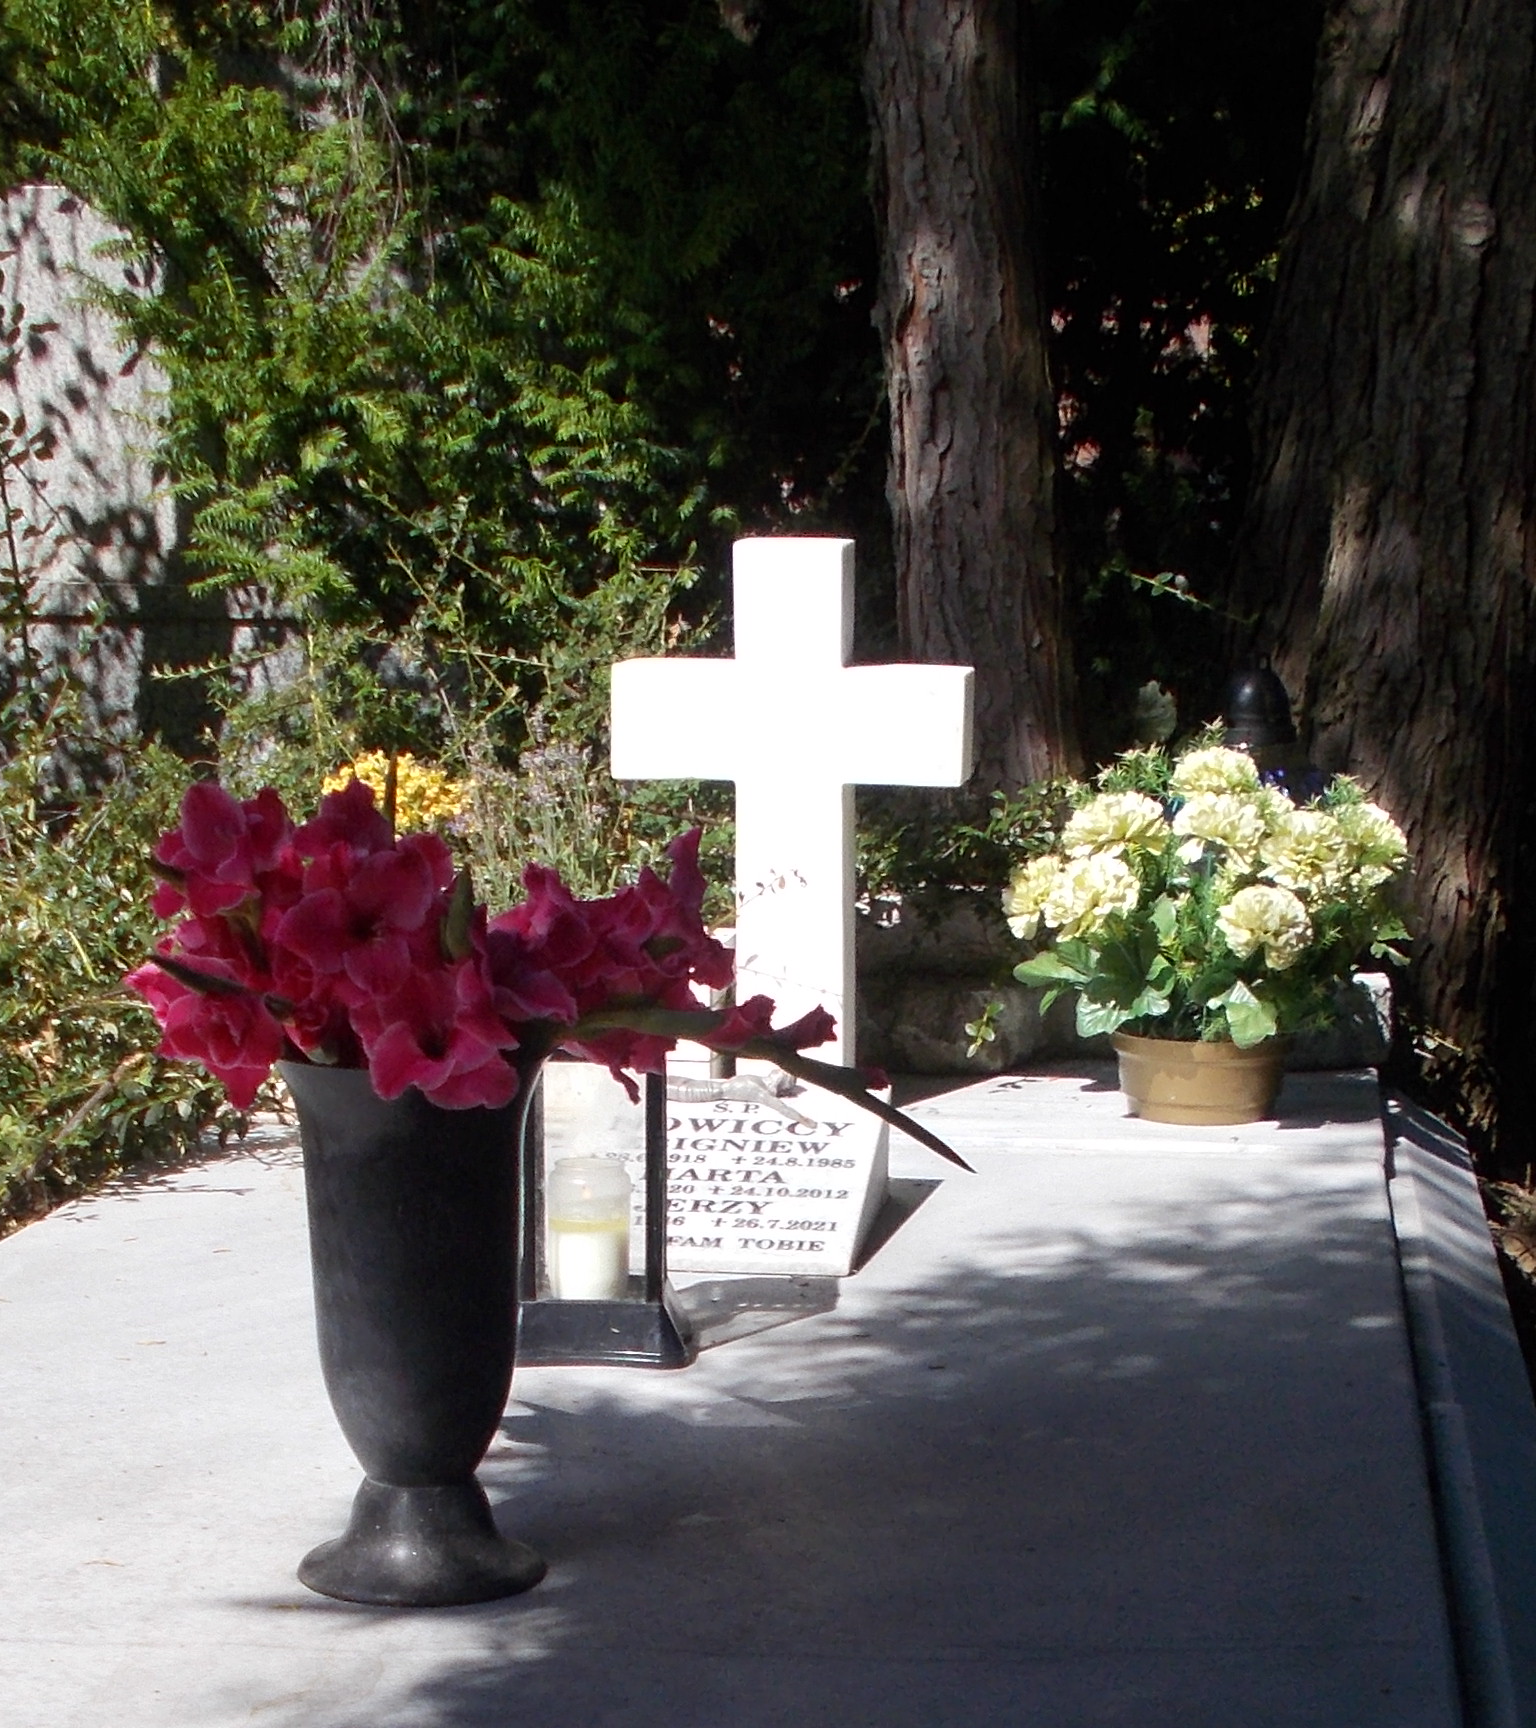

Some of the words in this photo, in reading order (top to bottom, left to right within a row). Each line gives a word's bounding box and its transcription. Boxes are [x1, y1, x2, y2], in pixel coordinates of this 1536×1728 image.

[666, 1137, 830, 1155] IGNIEW
[754, 1156, 856, 1168] 24.8.1985
[731, 1186, 849, 1199] 24.10.2012
[732, 1218, 838, 1232] 26.7.2021
[667, 1236, 724, 1248] FAM
[738, 1237, 826, 1252] TOBIE
